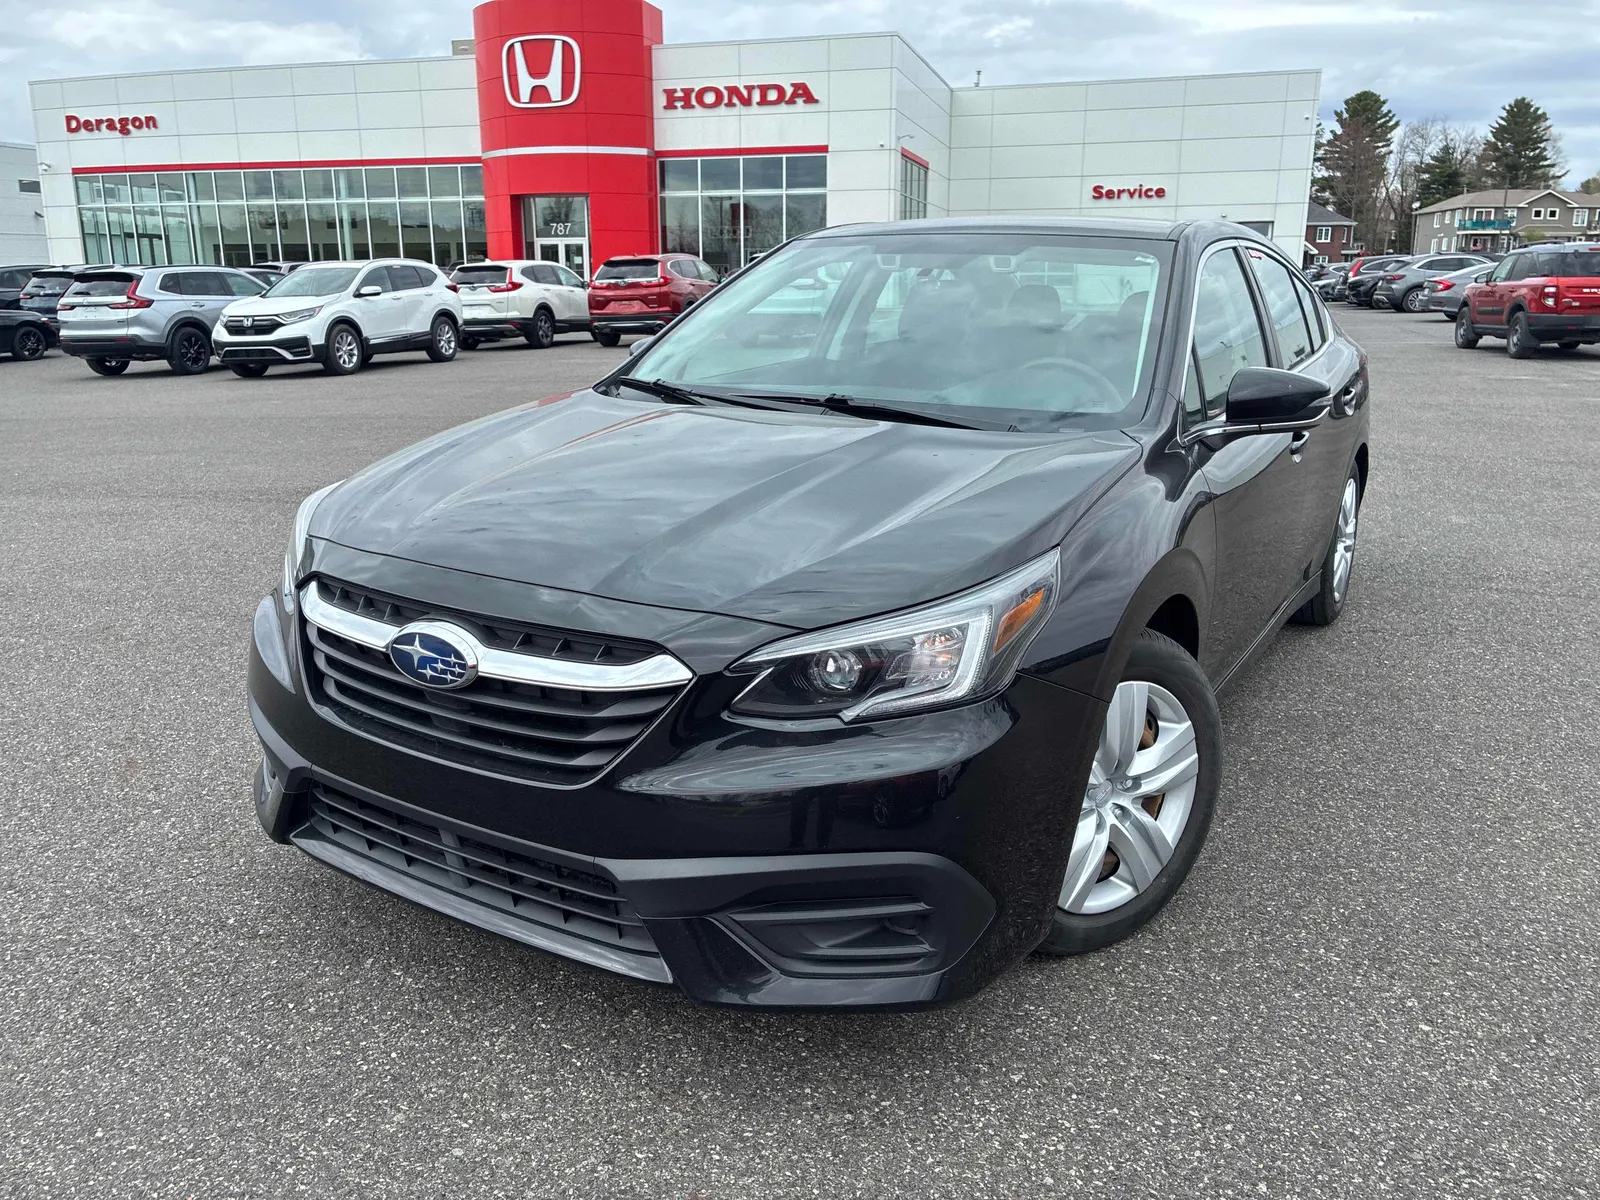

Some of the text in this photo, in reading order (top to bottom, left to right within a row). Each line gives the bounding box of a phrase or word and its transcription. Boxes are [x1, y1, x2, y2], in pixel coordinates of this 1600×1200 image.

[663, 82, 818, 110] HONDA
[65, 115, 158, 135] Deragon
[1092, 184, 1165, 199] Service
[549, 222, 572, 236] 787
